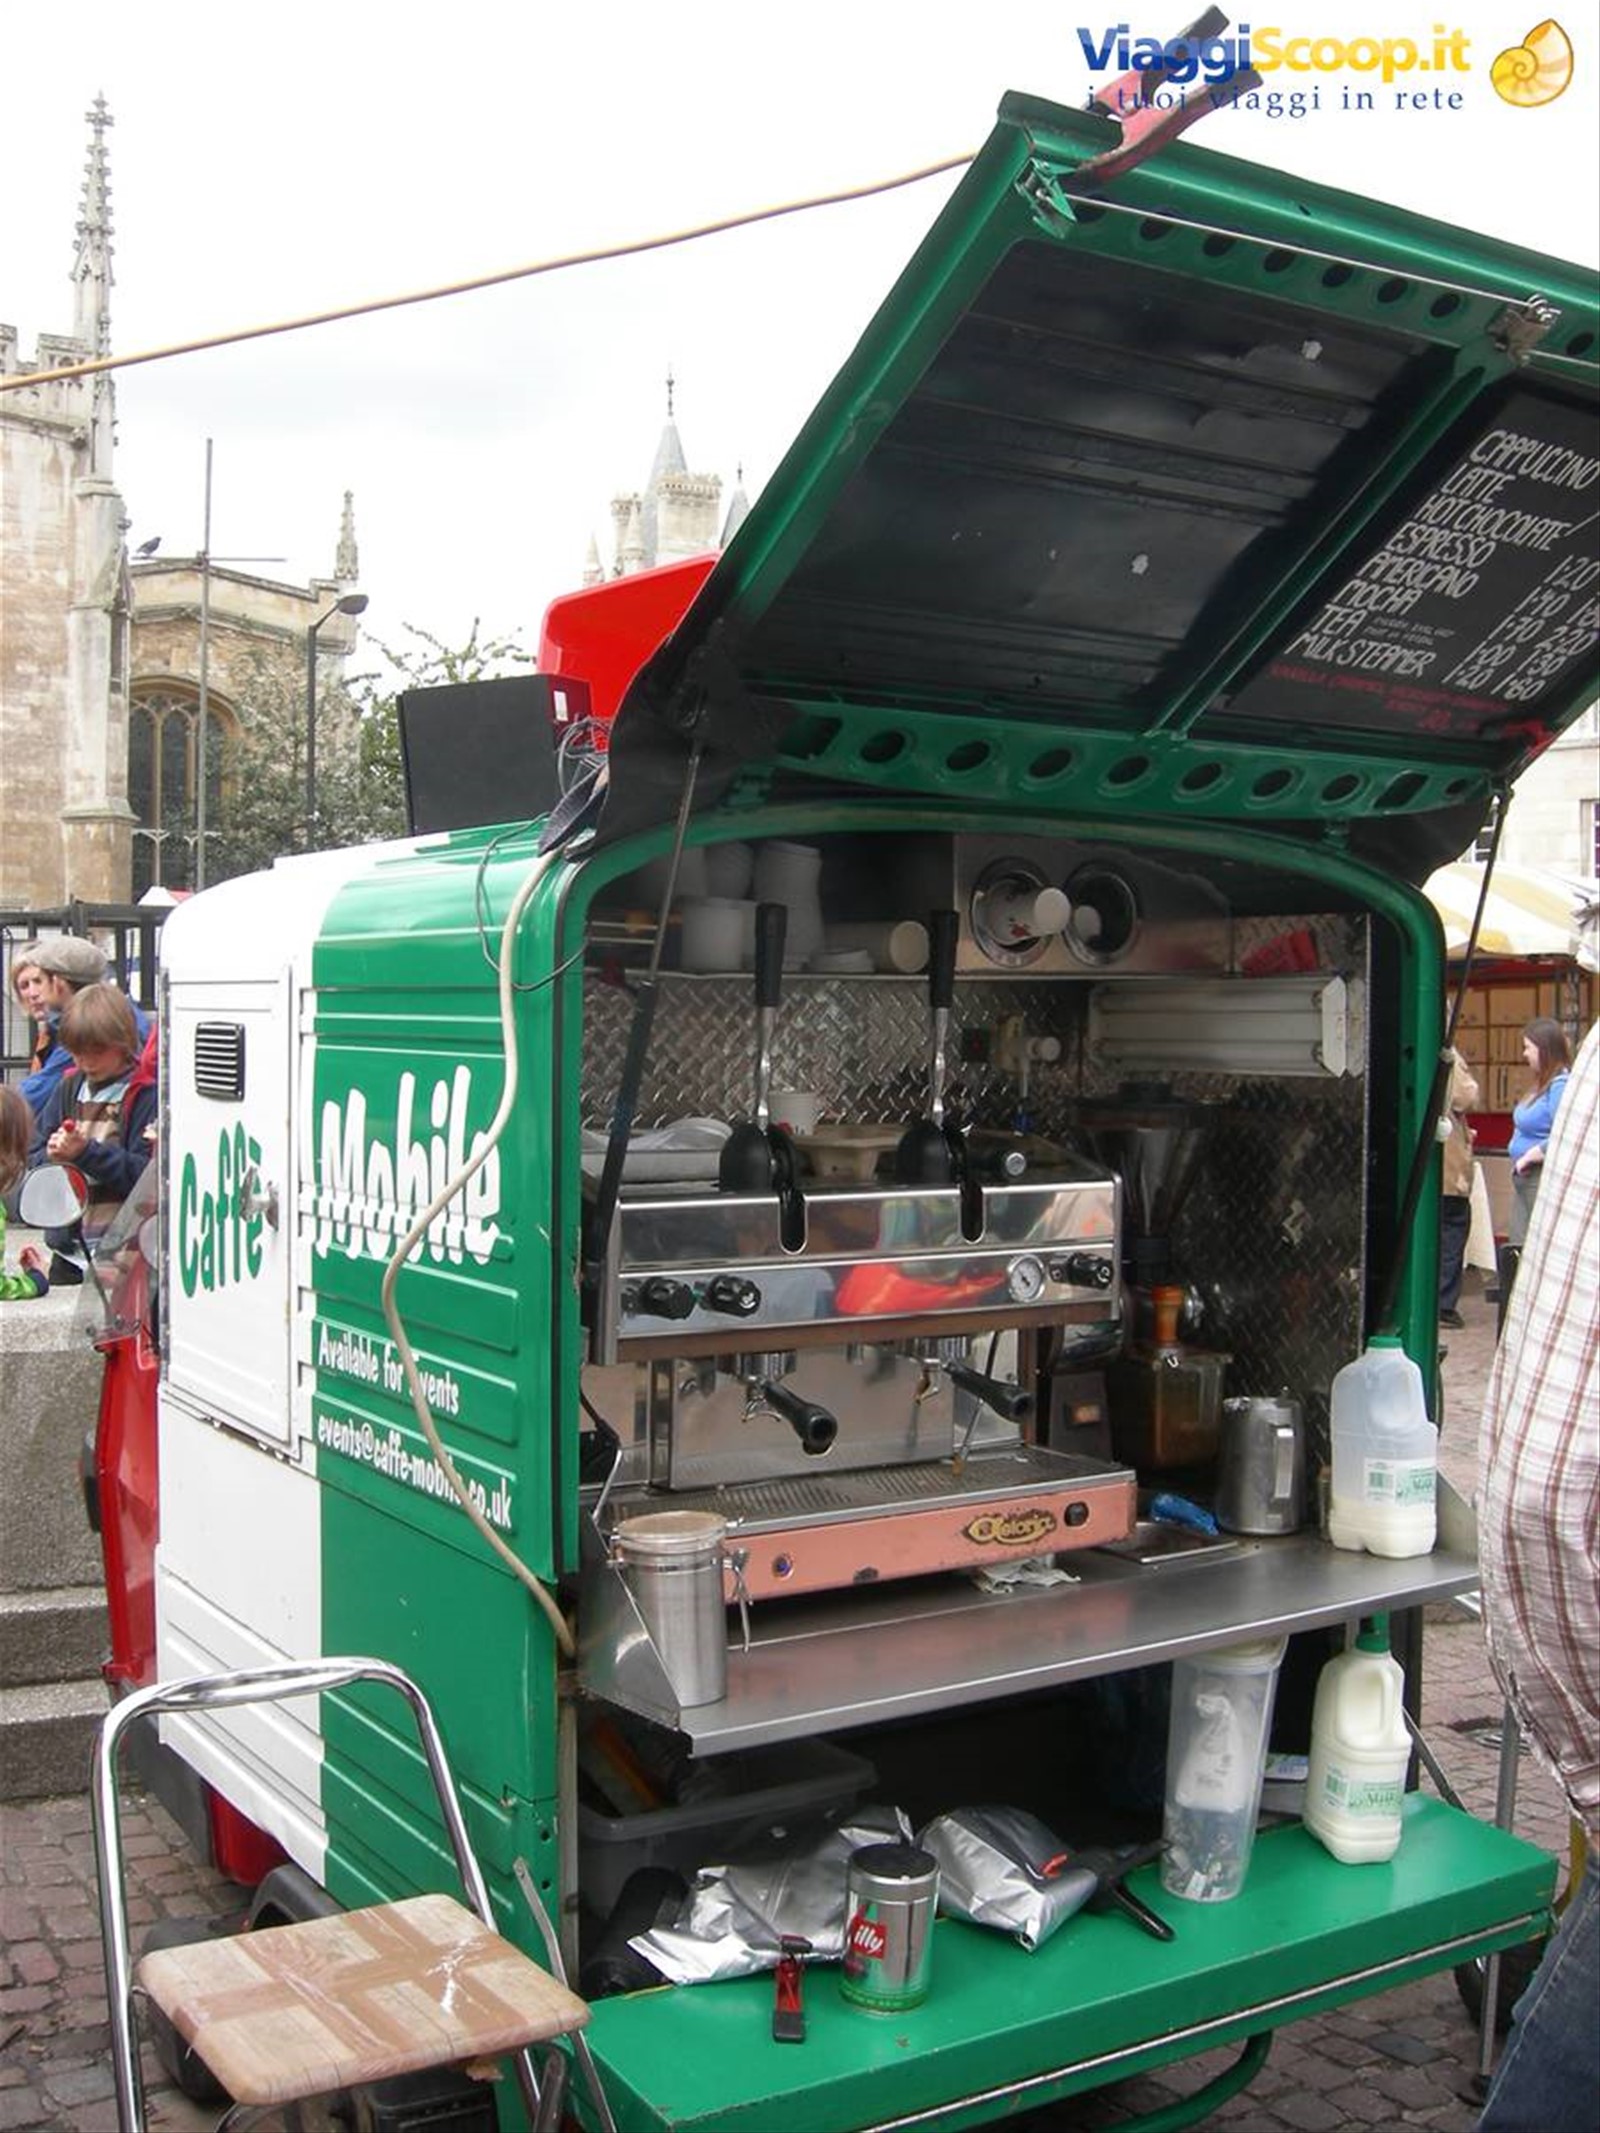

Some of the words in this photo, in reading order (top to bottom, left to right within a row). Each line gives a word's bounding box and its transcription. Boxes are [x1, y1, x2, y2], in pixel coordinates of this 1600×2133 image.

[1441, 463, 1516, 503] LATTE
[1470, 430, 1600, 490] CAPPUCCINO
[1414, 494, 1471, 526] HOT
[1385, 521, 1496, 568] ESPRESSO
[1333, 579, 1424, 615] MOCHA
[1357, 551, 1479, 598] AMERICANO
[1311, 604, 1368, 638] TEA
[1284, 632, 1349, 662] MILK
[1336, 638, 1437, 678] STEAMER
[315, 1065, 500, 1265] Mobile
[318, 1321, 379, 1383] Available
[383, 1340, 404, 1393] for
[409, 1352, 460, 1415] vents
[853, 1925, 884, 1954] illy
